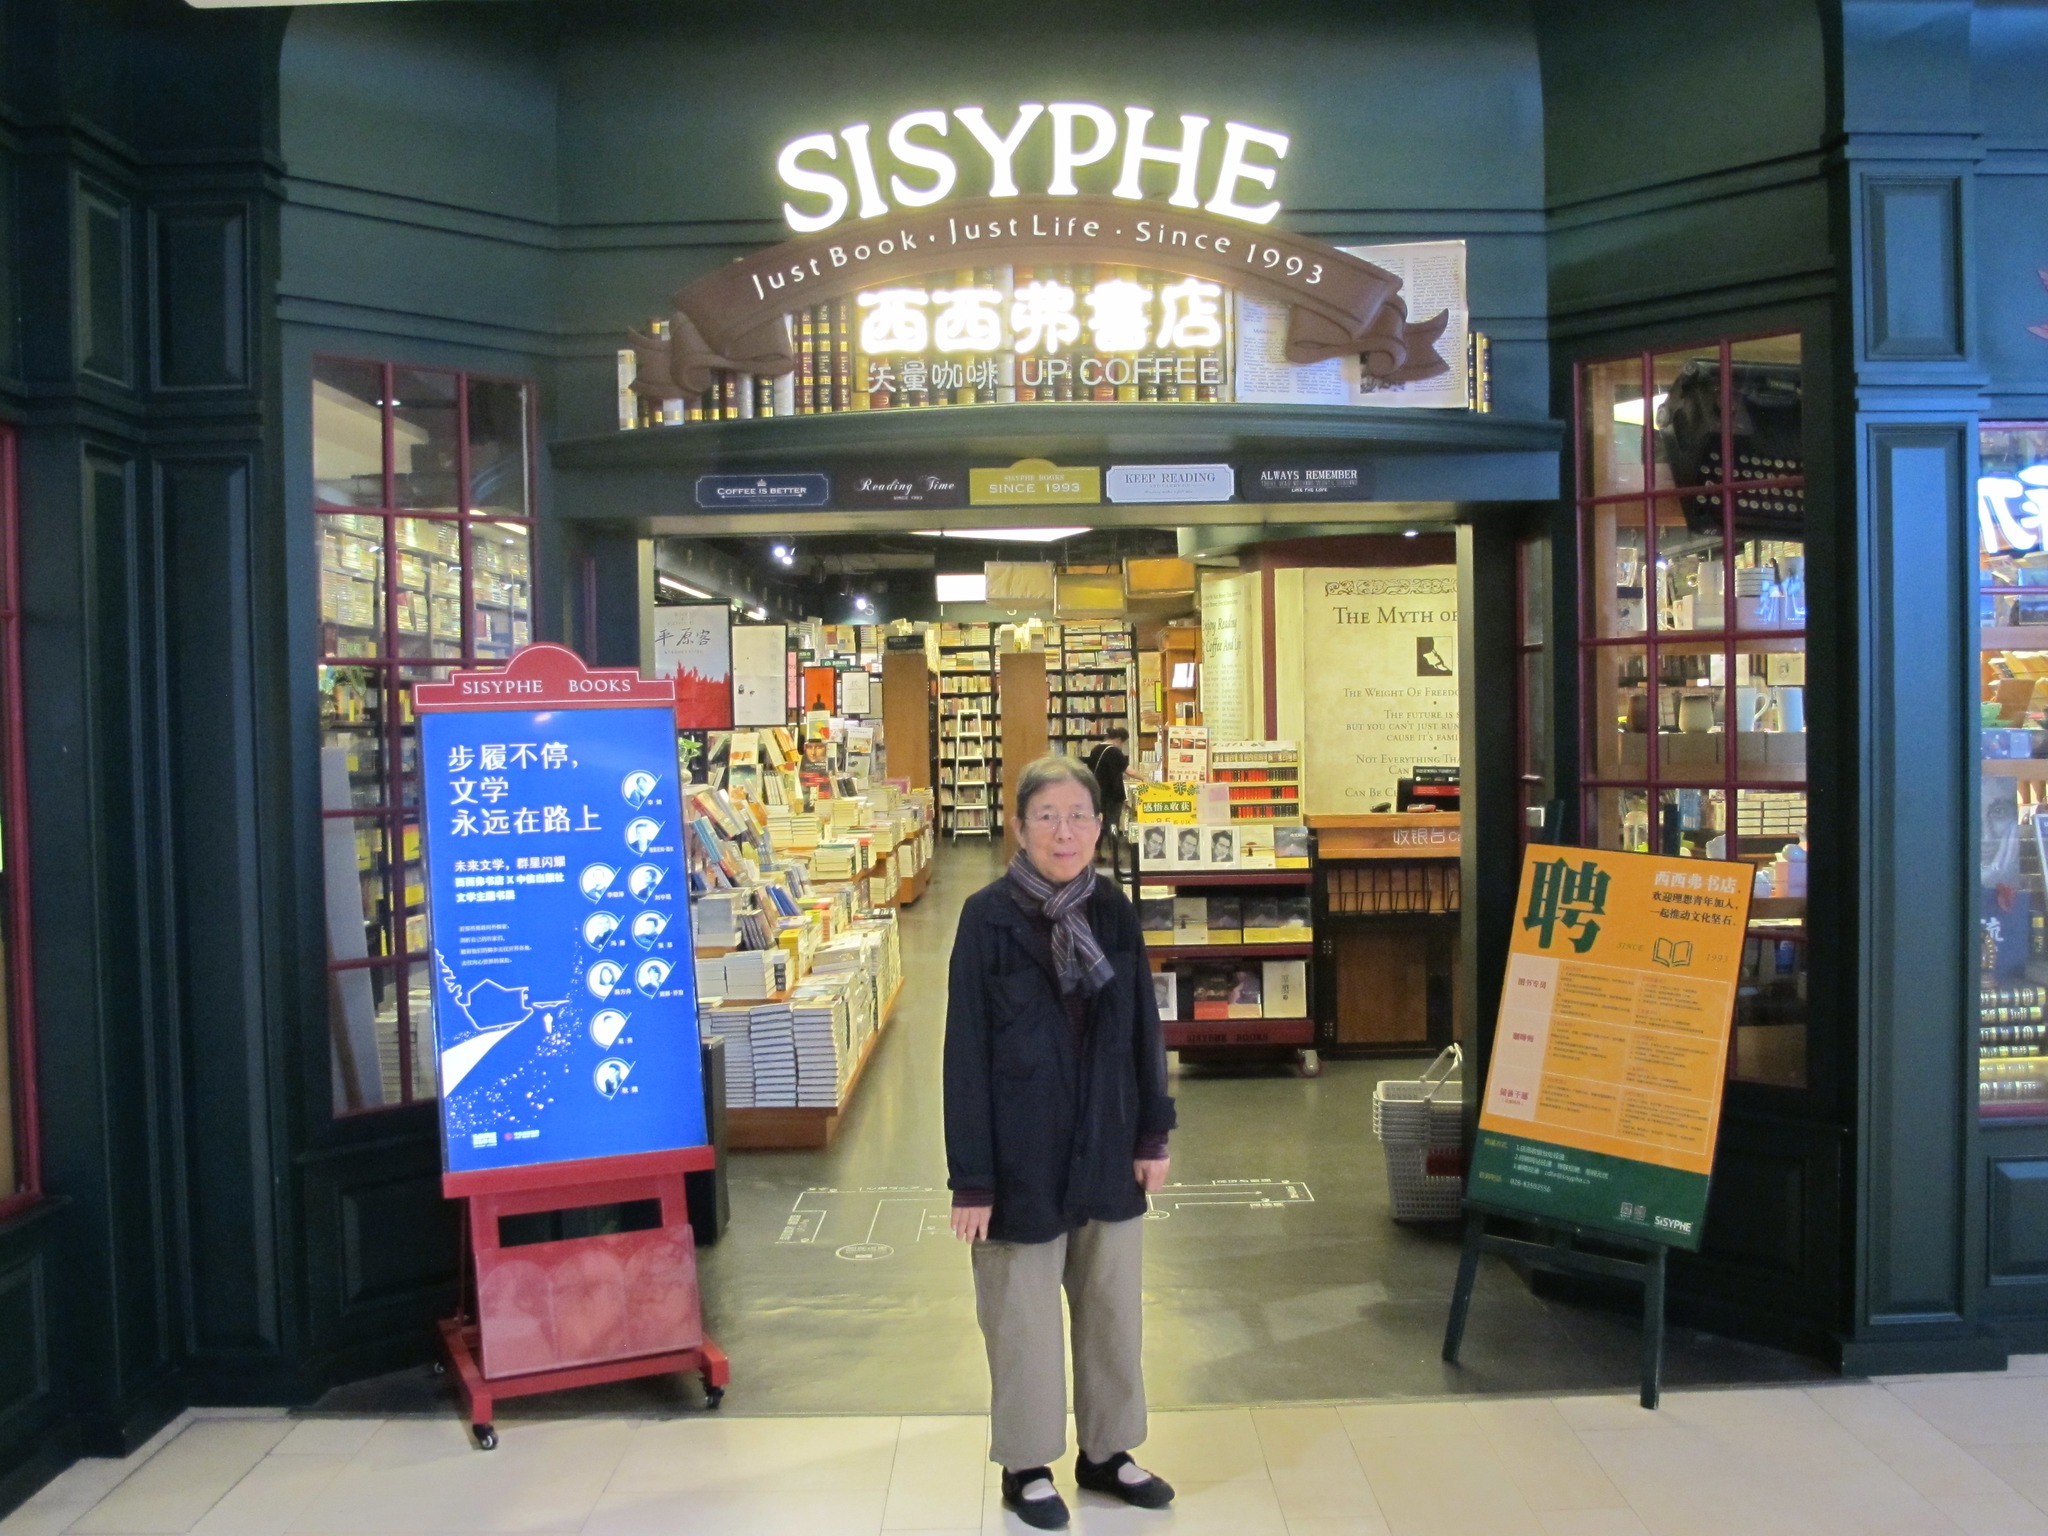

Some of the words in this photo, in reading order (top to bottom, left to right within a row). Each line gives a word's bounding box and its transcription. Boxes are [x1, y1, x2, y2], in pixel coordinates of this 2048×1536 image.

[777, 103, 1290, 233] SISYPHE
[752, 258, 820, 300] Just
[829, 230, 917, 268] Book
[949, 218, 1017, 245] Just
[1032, 214, 1100, 237] Life
[1136, 221, 1231, 253] Since
[1246, 243, 1324, 285] 1993
[868, 361, 999, 394] 矢量咖啡
[1021, 358, 1068, 387] UP
[1079, 357, 1221, 387] COFFEE
[1125, 473, 1156, 484] KEEP
[1162, 472, 1216, 483] READING
[1260, 470, 1300, 480] ALWAYS
[1305, 469, 1358, 480] REMEMBER
[716, 487, 757, 496] COFFEE
[758, 487, 768, 495] IS
[769, 486, 807, 495] BETTER
[856, 478, 913, 496] Reading
[922, 475, 956, 491] Time
[989, 483, 1036, 494] SINCE
[1045, 482, 1080, 493] 1993
[1332, 606, 1371, 625] THE
[1377, 606, 1434, 624] MYTH
[655, 628, 711, 647] 平原客
[462, 680, 543, 695] SISYPHE
[569, 679, 631, 693] BOOKS
[1343, 687, 1362, 698] THE
[1364, 687, 1404, 698] WEIGHT
[1346, 723, 1364, 731] BUT
[1367, 723, 1386, 731] YOU
[1356, 754, 1377, 764] NOT
[1381, 753, 1441, 764] EVERYTHING
[449, 776, 510, 805] 文学
[451, 805, 602, 837] 永远在路上
[1393, 828, 1445, 845] 收银台
[1522, 857, 1612, 953] 聘
